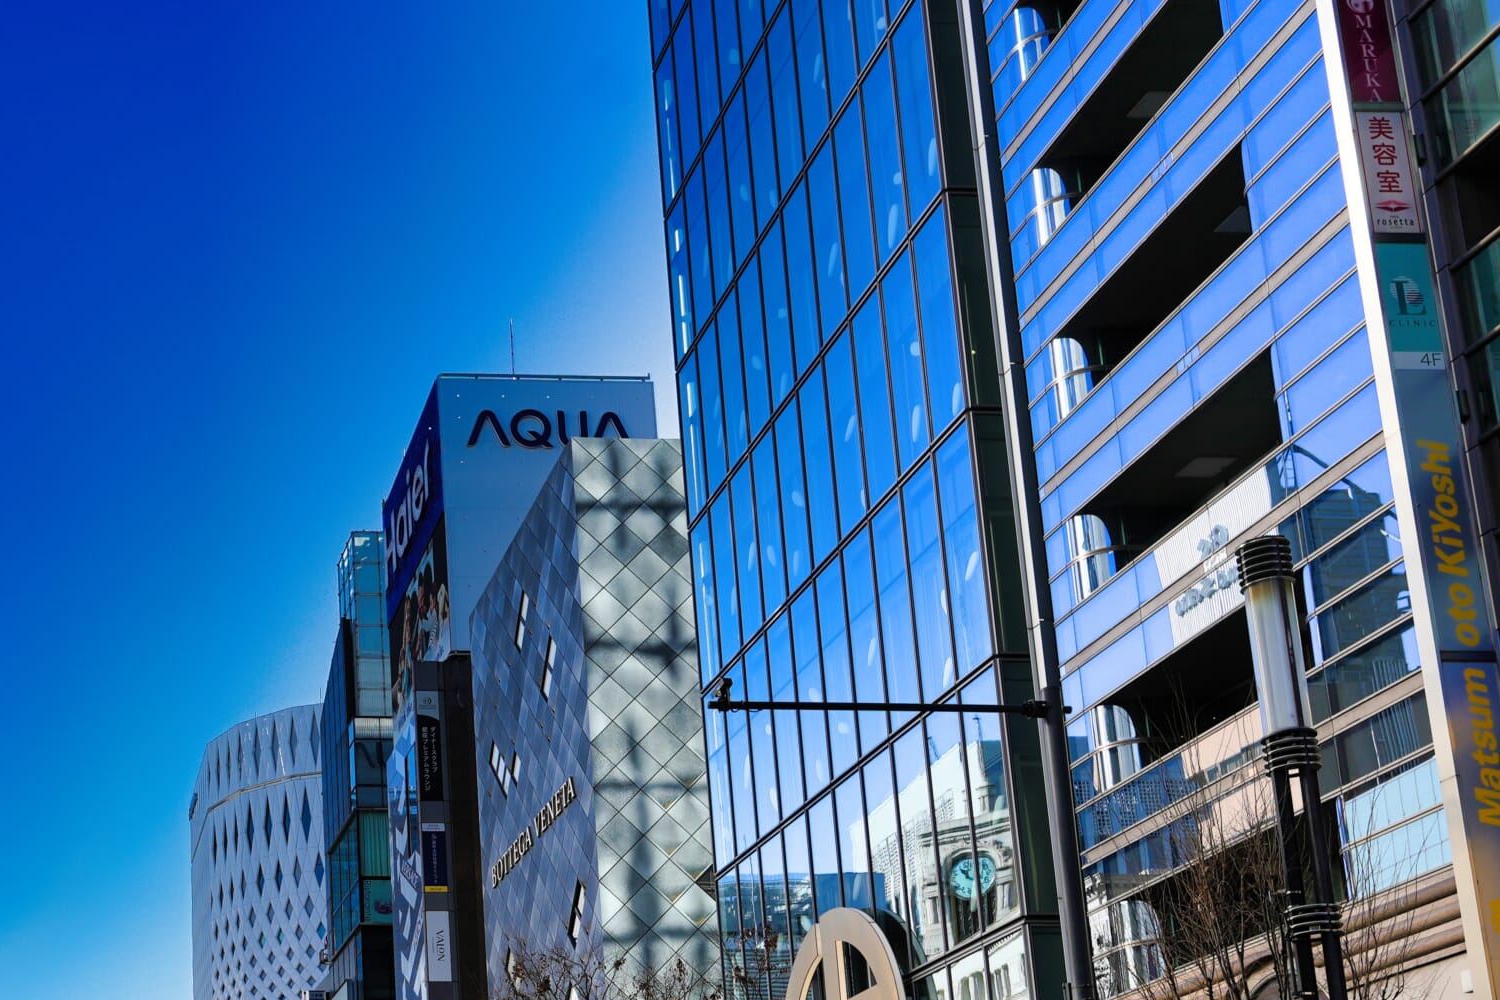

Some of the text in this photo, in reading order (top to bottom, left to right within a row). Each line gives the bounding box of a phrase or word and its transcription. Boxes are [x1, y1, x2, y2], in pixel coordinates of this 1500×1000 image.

[1355, 14, 1382, 103] MARUKA
[1368, 116, 1403, 193] 美容室
[1377, 217, 1415, 226] rosetta
[1389, 319, 1436, 328] CLINIC
[1420, 352, 1441, 367] 4F
[466, 408, 630, 448] AQUA
[386, 437, 430, 586] Haier
[491, 776, 576, 889] BOTTEGA VENETA
